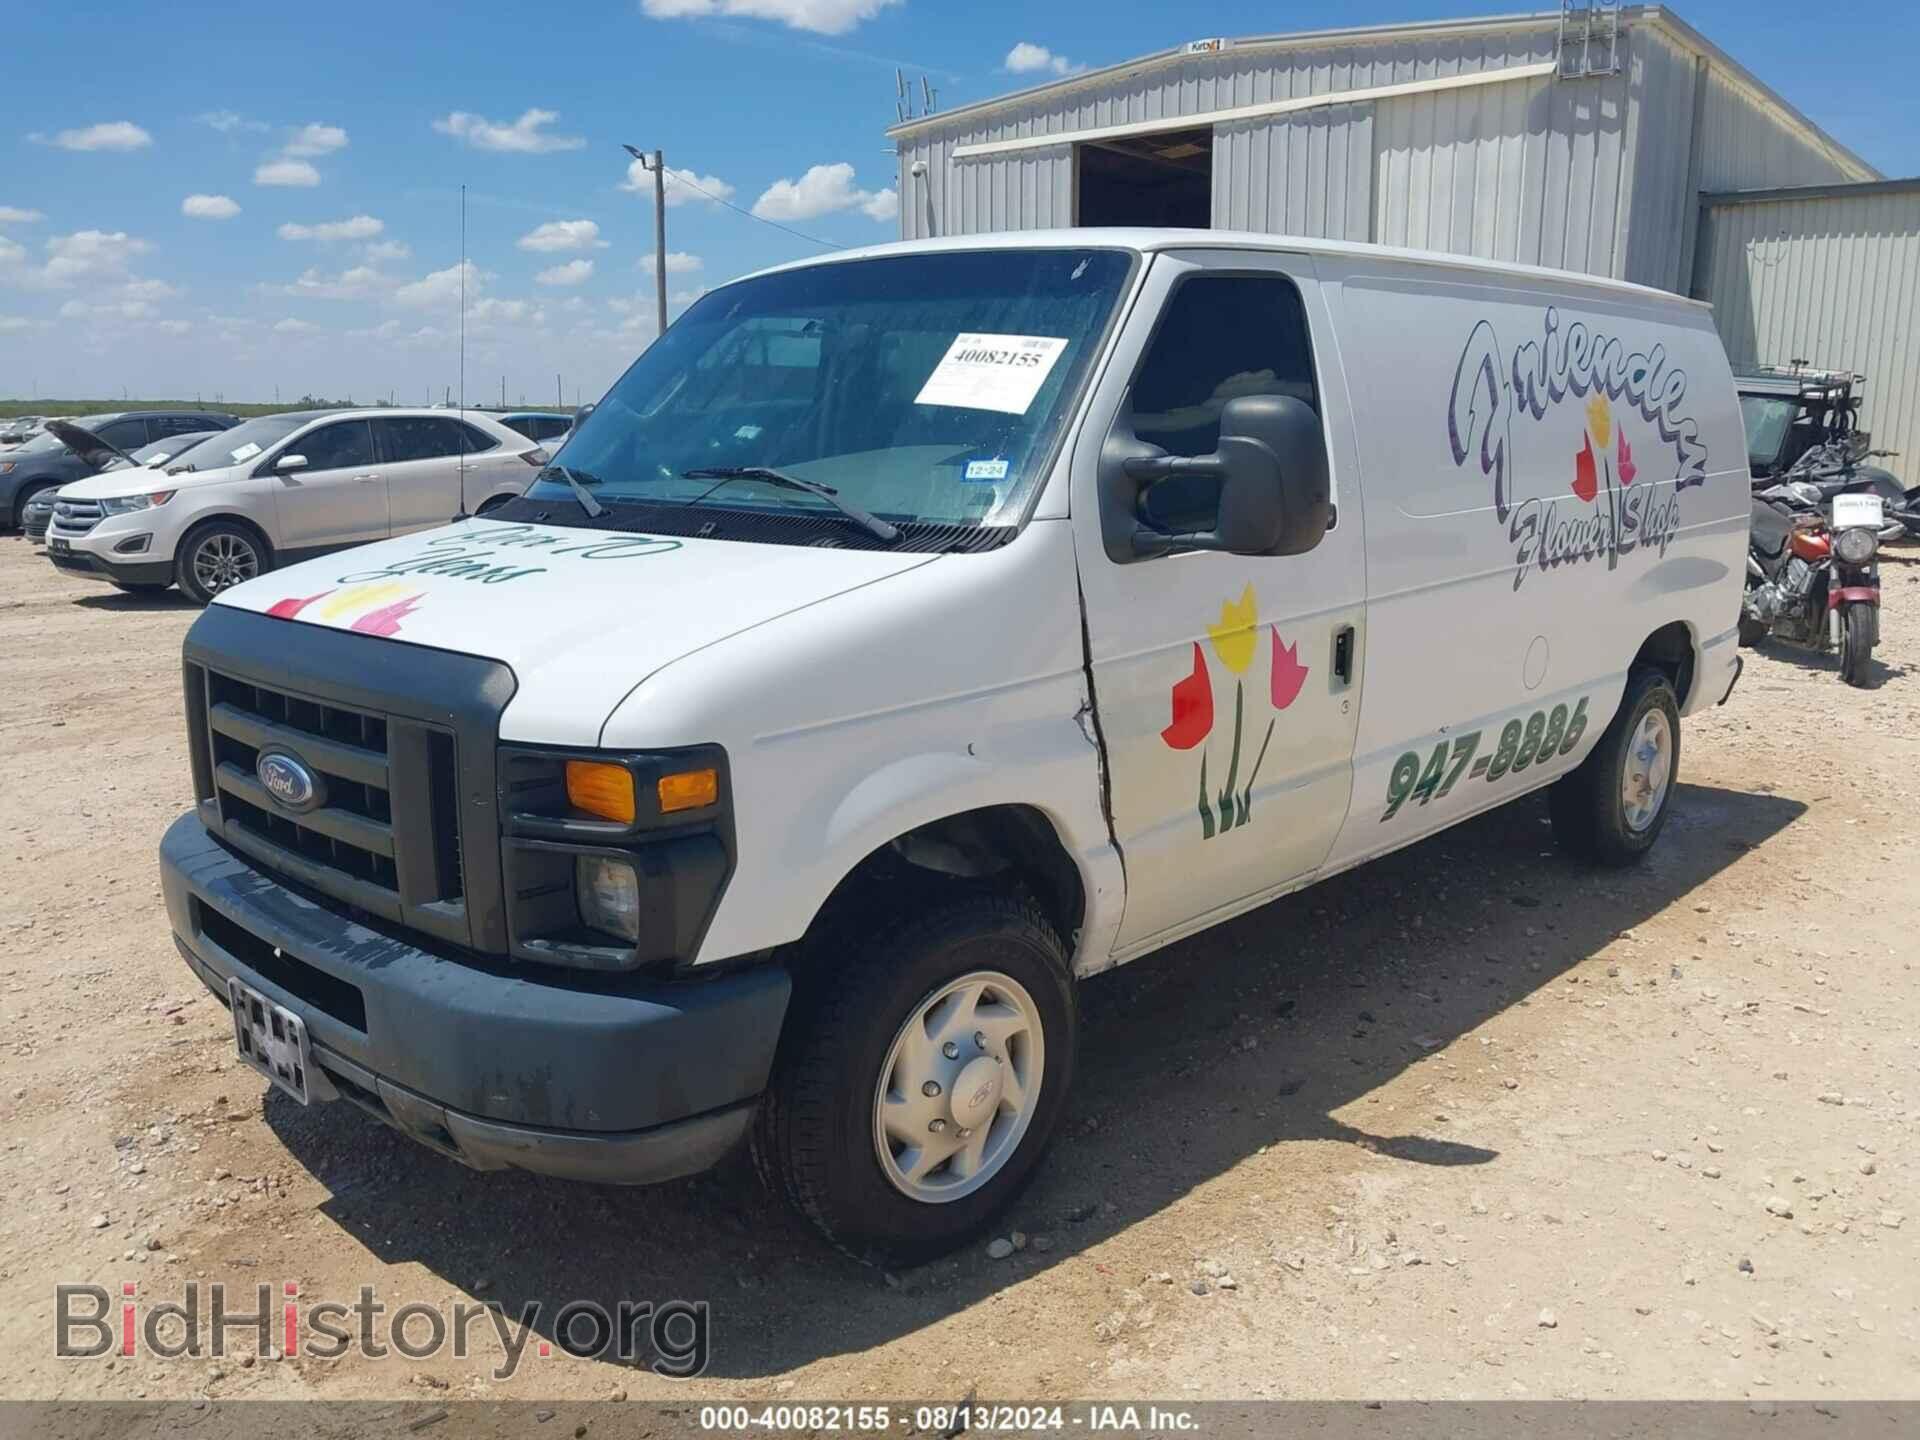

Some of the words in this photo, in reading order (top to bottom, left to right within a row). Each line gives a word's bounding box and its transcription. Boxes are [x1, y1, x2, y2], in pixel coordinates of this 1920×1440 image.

[954, 348, 1043, 367] 40082155
[1509, 497, 1614, 592] Flower
[1619, 481, 1680, 559] Shop
[337, 547, 549, 585] Years
[265, 762, 294, 795] Ford
[1378, 695, 1590, 824] 947-8886
